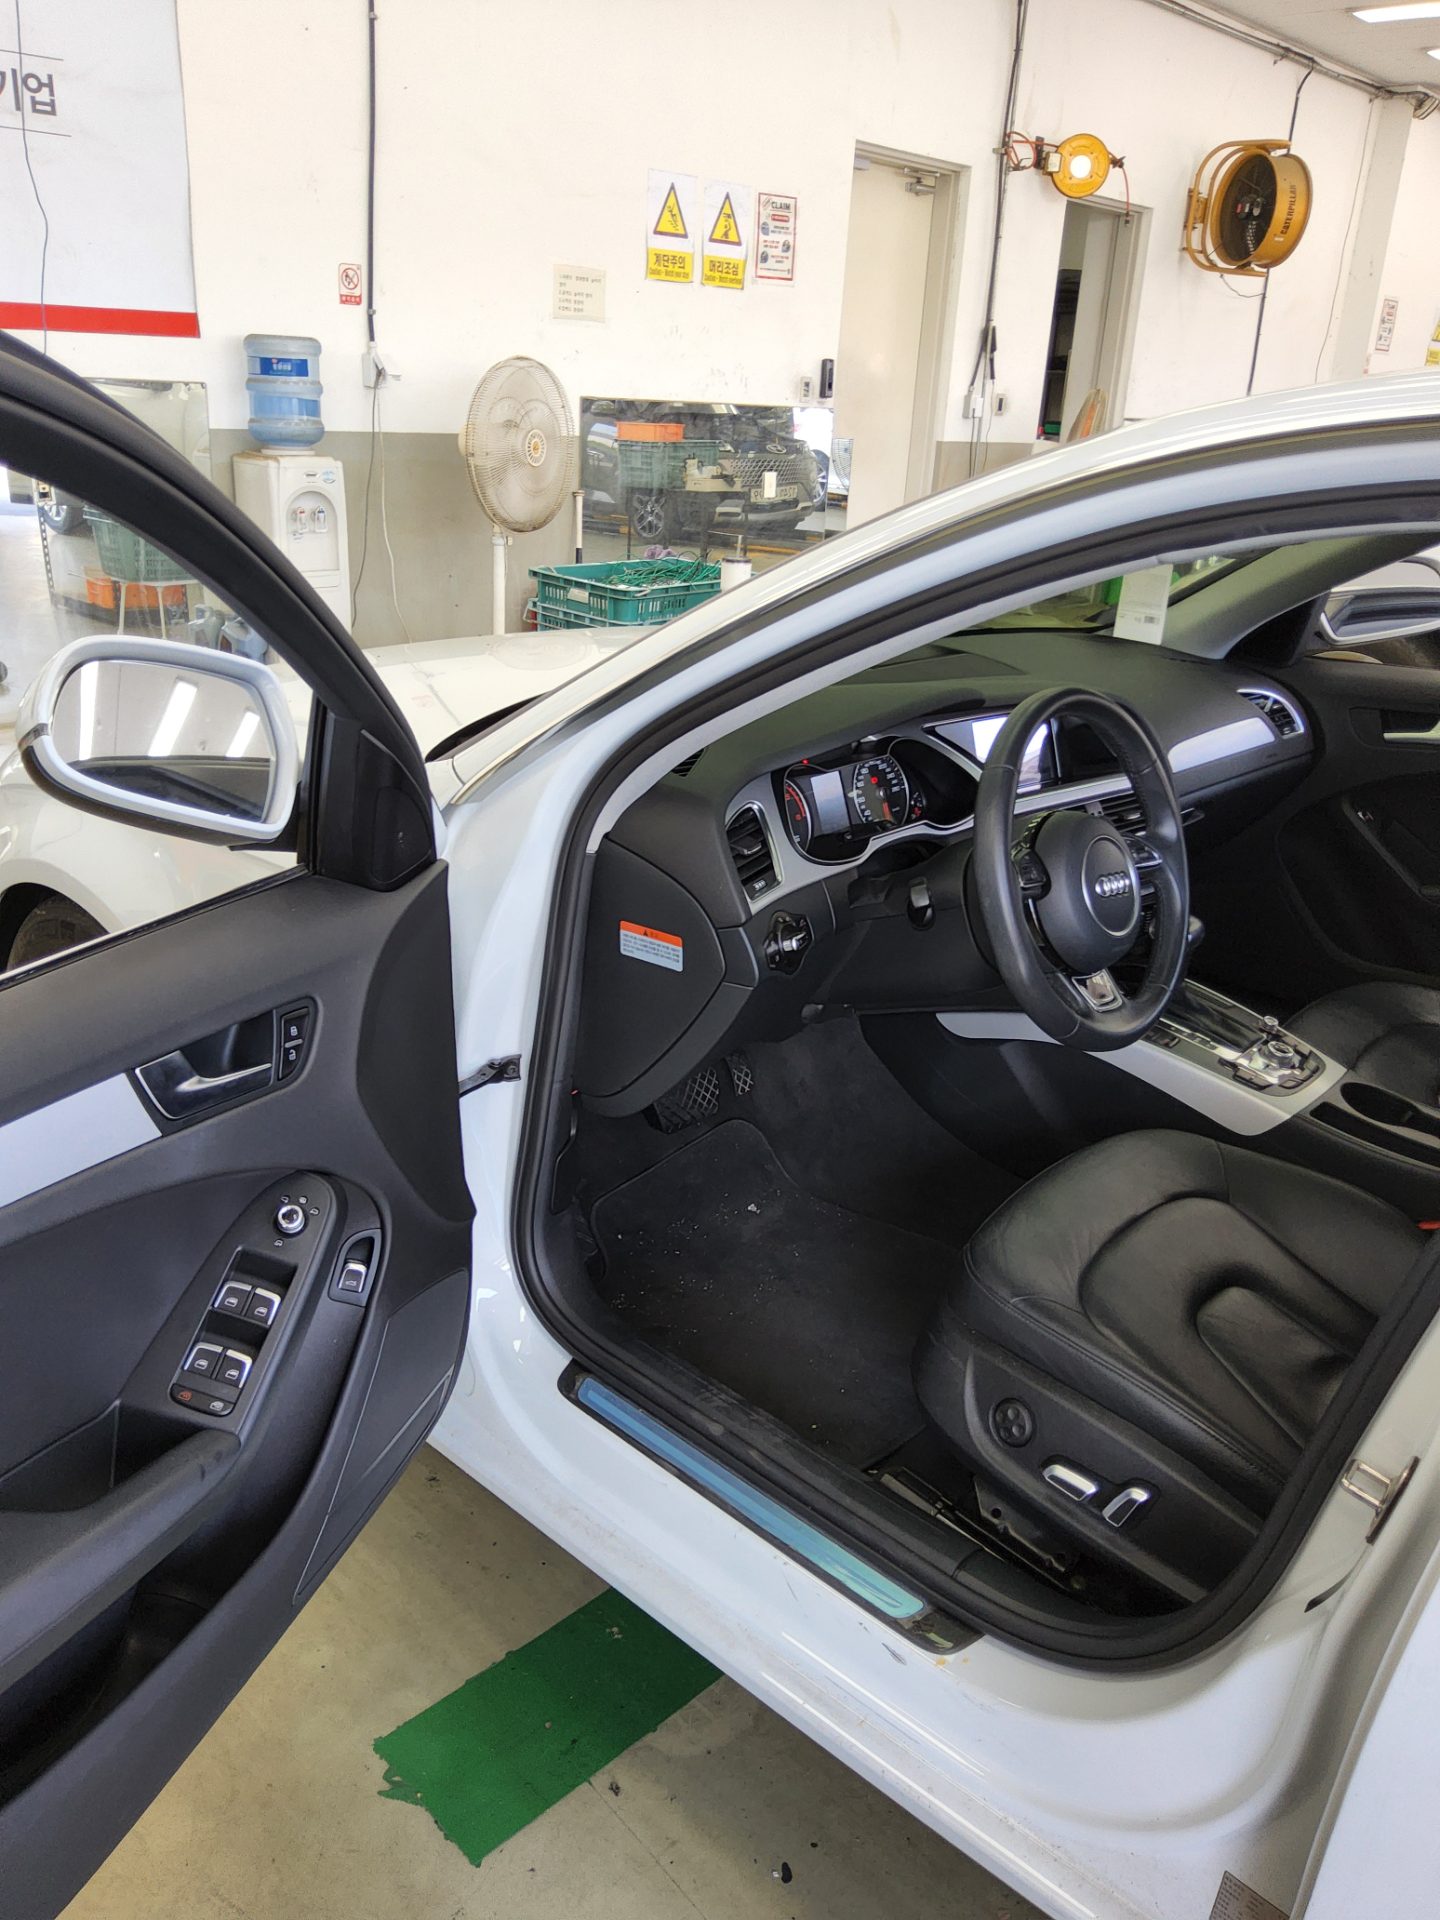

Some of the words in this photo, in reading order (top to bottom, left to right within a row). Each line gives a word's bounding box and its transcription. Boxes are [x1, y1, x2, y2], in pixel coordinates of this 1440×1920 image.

[771, 201, 791, 210] CLAIM
[654, 253, 686, 269] 계단주의
[709, 260, 739, 276] 머리조심
